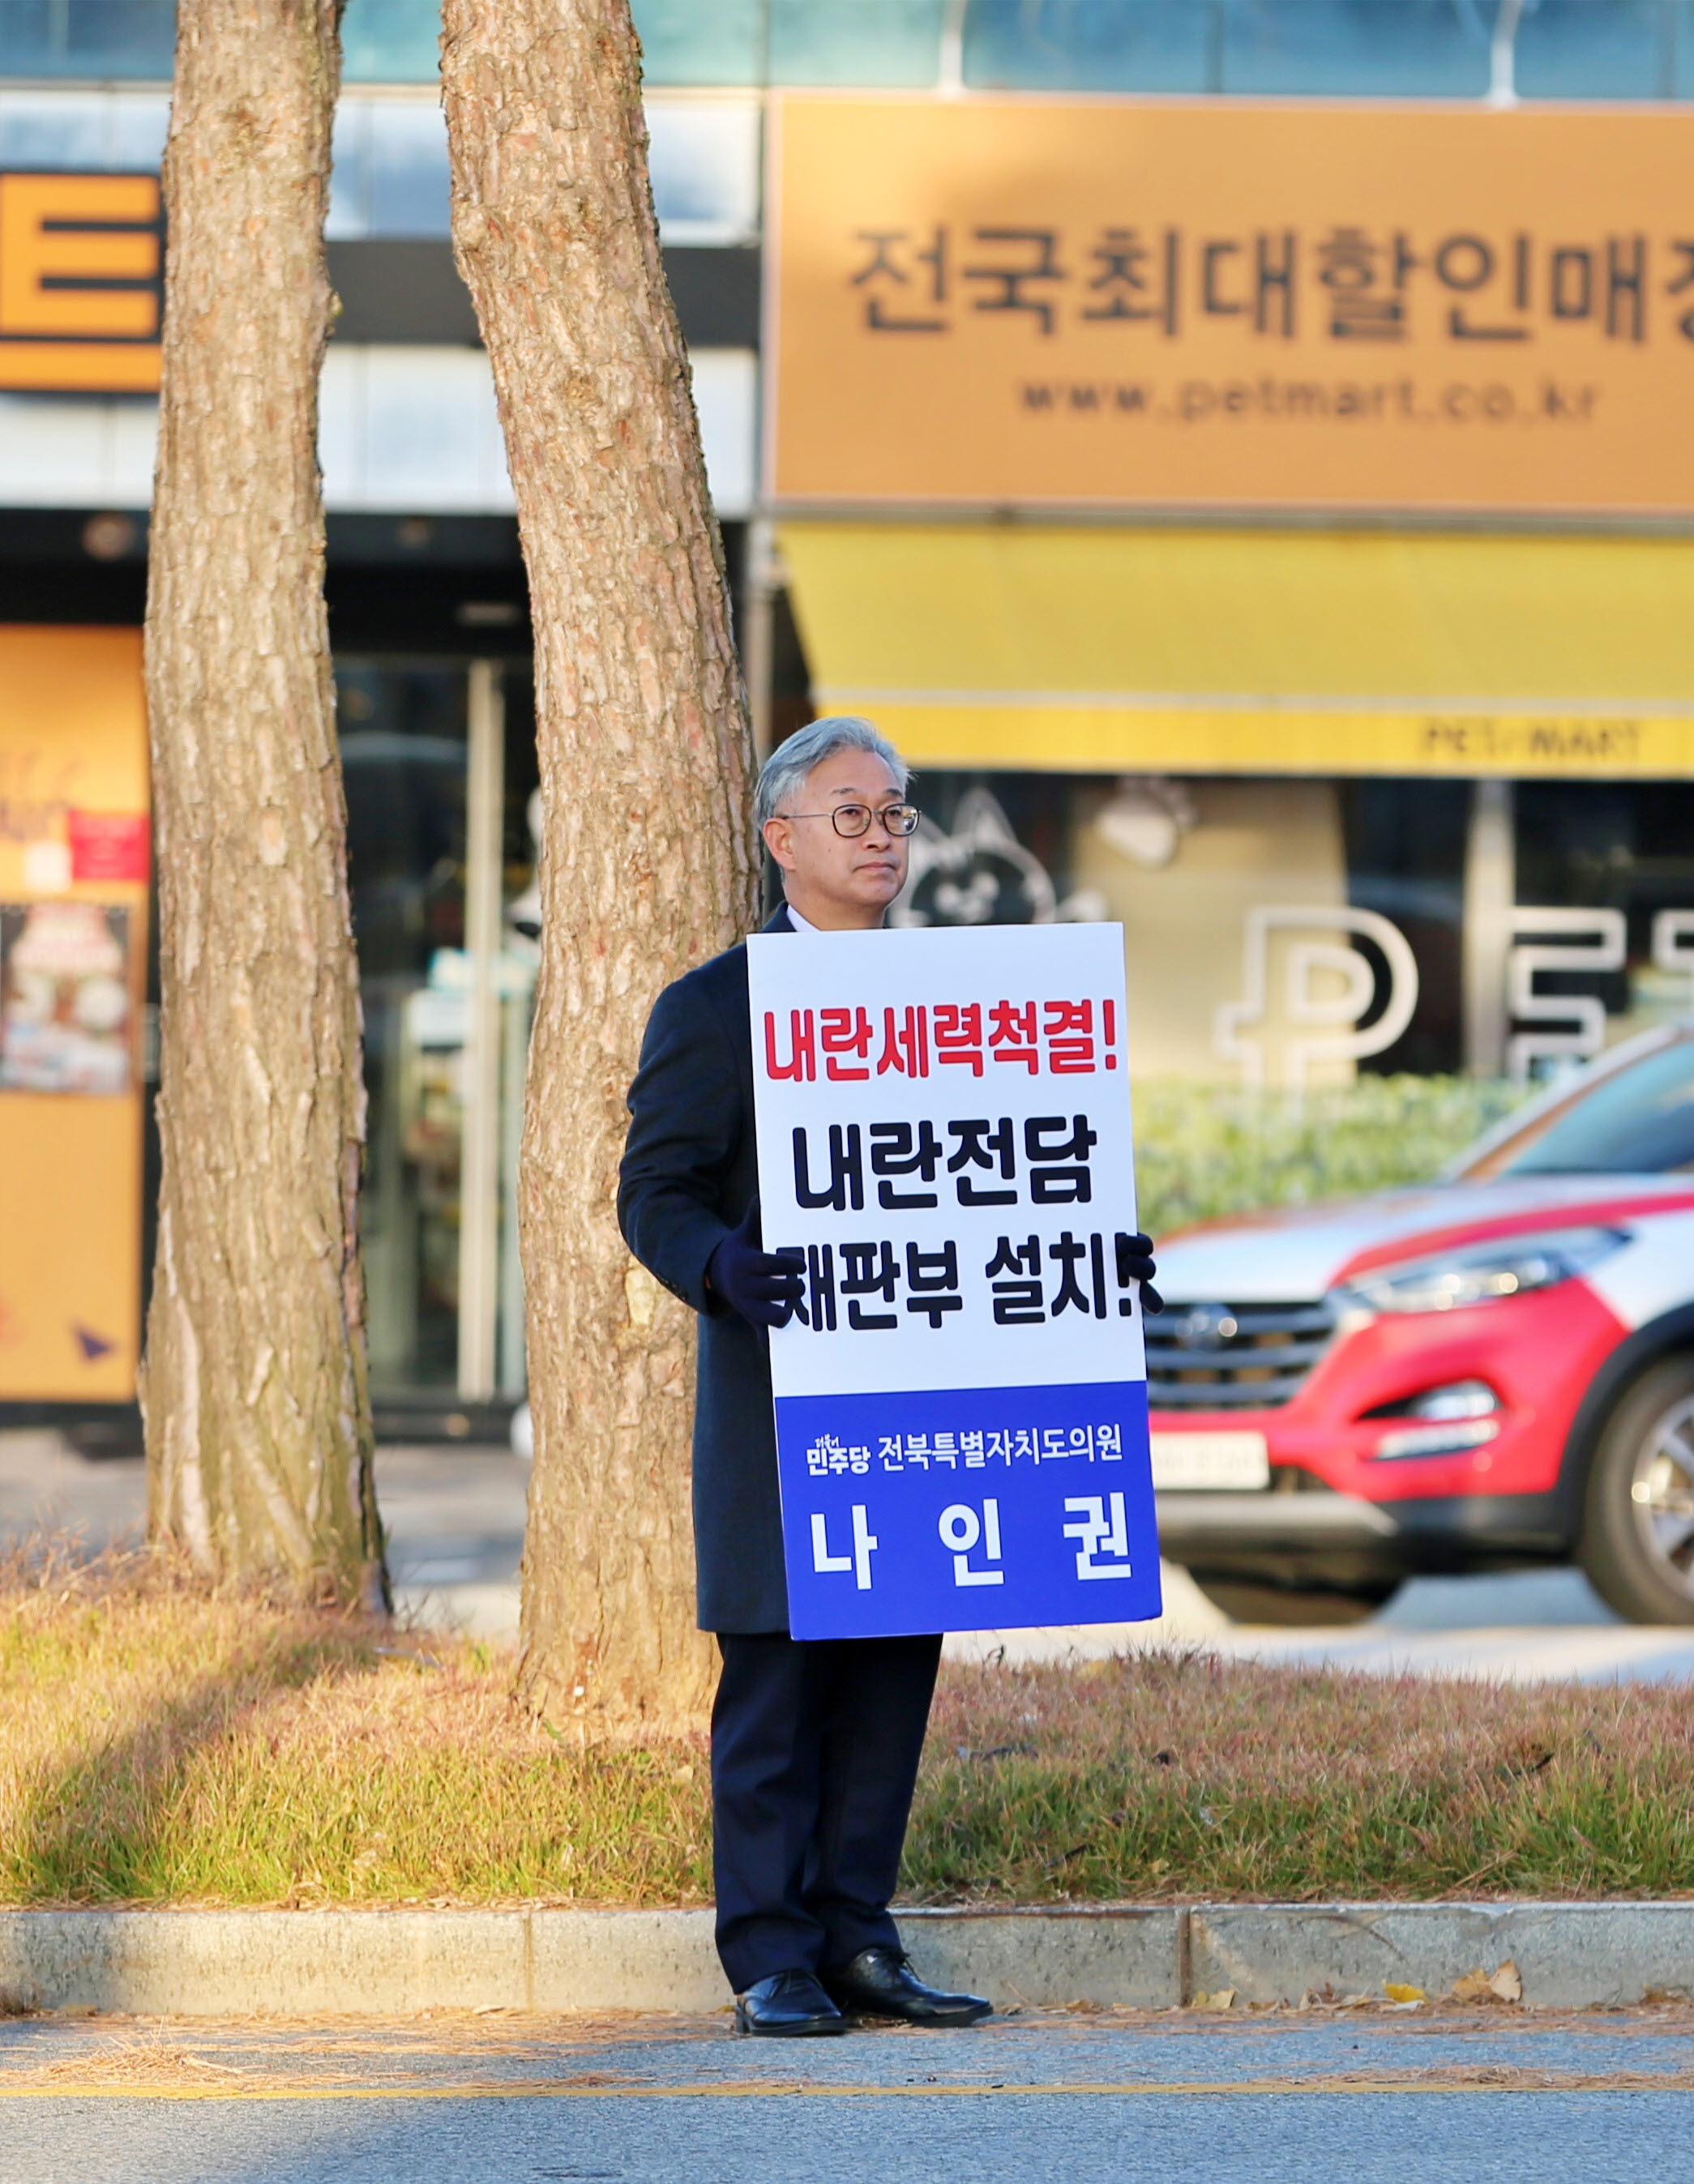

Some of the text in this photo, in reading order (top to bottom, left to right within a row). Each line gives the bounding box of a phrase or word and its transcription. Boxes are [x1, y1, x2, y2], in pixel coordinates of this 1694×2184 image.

[1020, 373, 1597, 426] www.petmart.co.kr
[764, 998, 1117, 1082] 내란세력척결!
[792, 1114, 1097, 1211] 내란전담
[806, 1446, 871, 1477] 민주당
[878, 1423, 1123, 1472] 전북특별자치도의원
